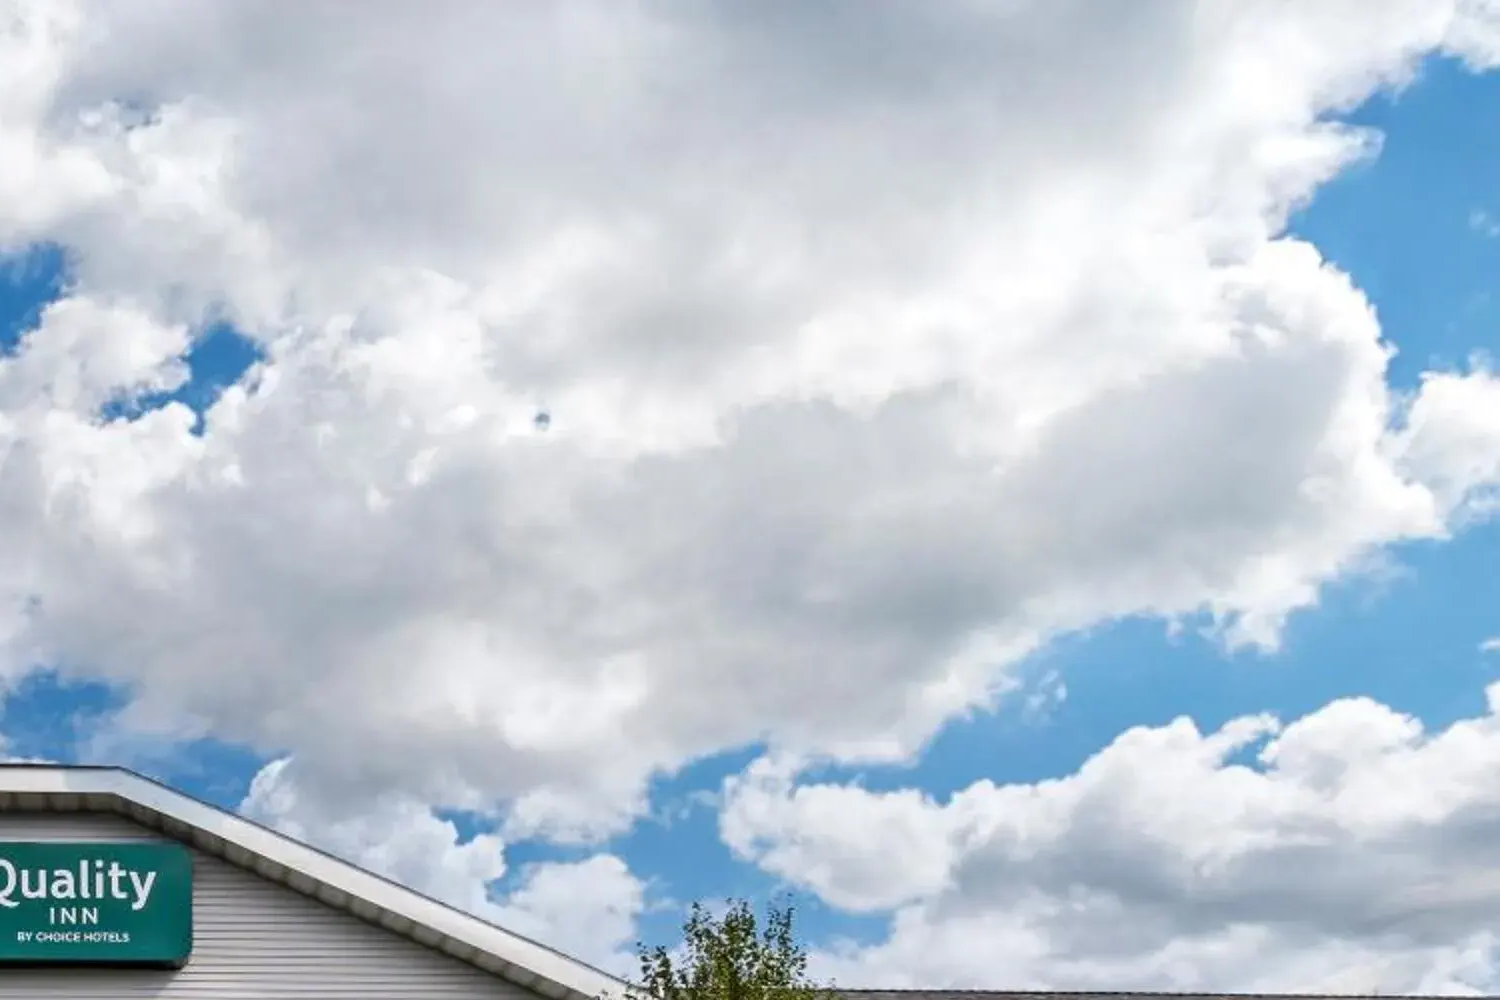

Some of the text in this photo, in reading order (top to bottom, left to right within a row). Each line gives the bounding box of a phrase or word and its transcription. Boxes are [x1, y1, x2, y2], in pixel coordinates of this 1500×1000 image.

[49, 907, 99, 925] INN
[17, 932, 130, 943] BY CHOICE HOTELS
